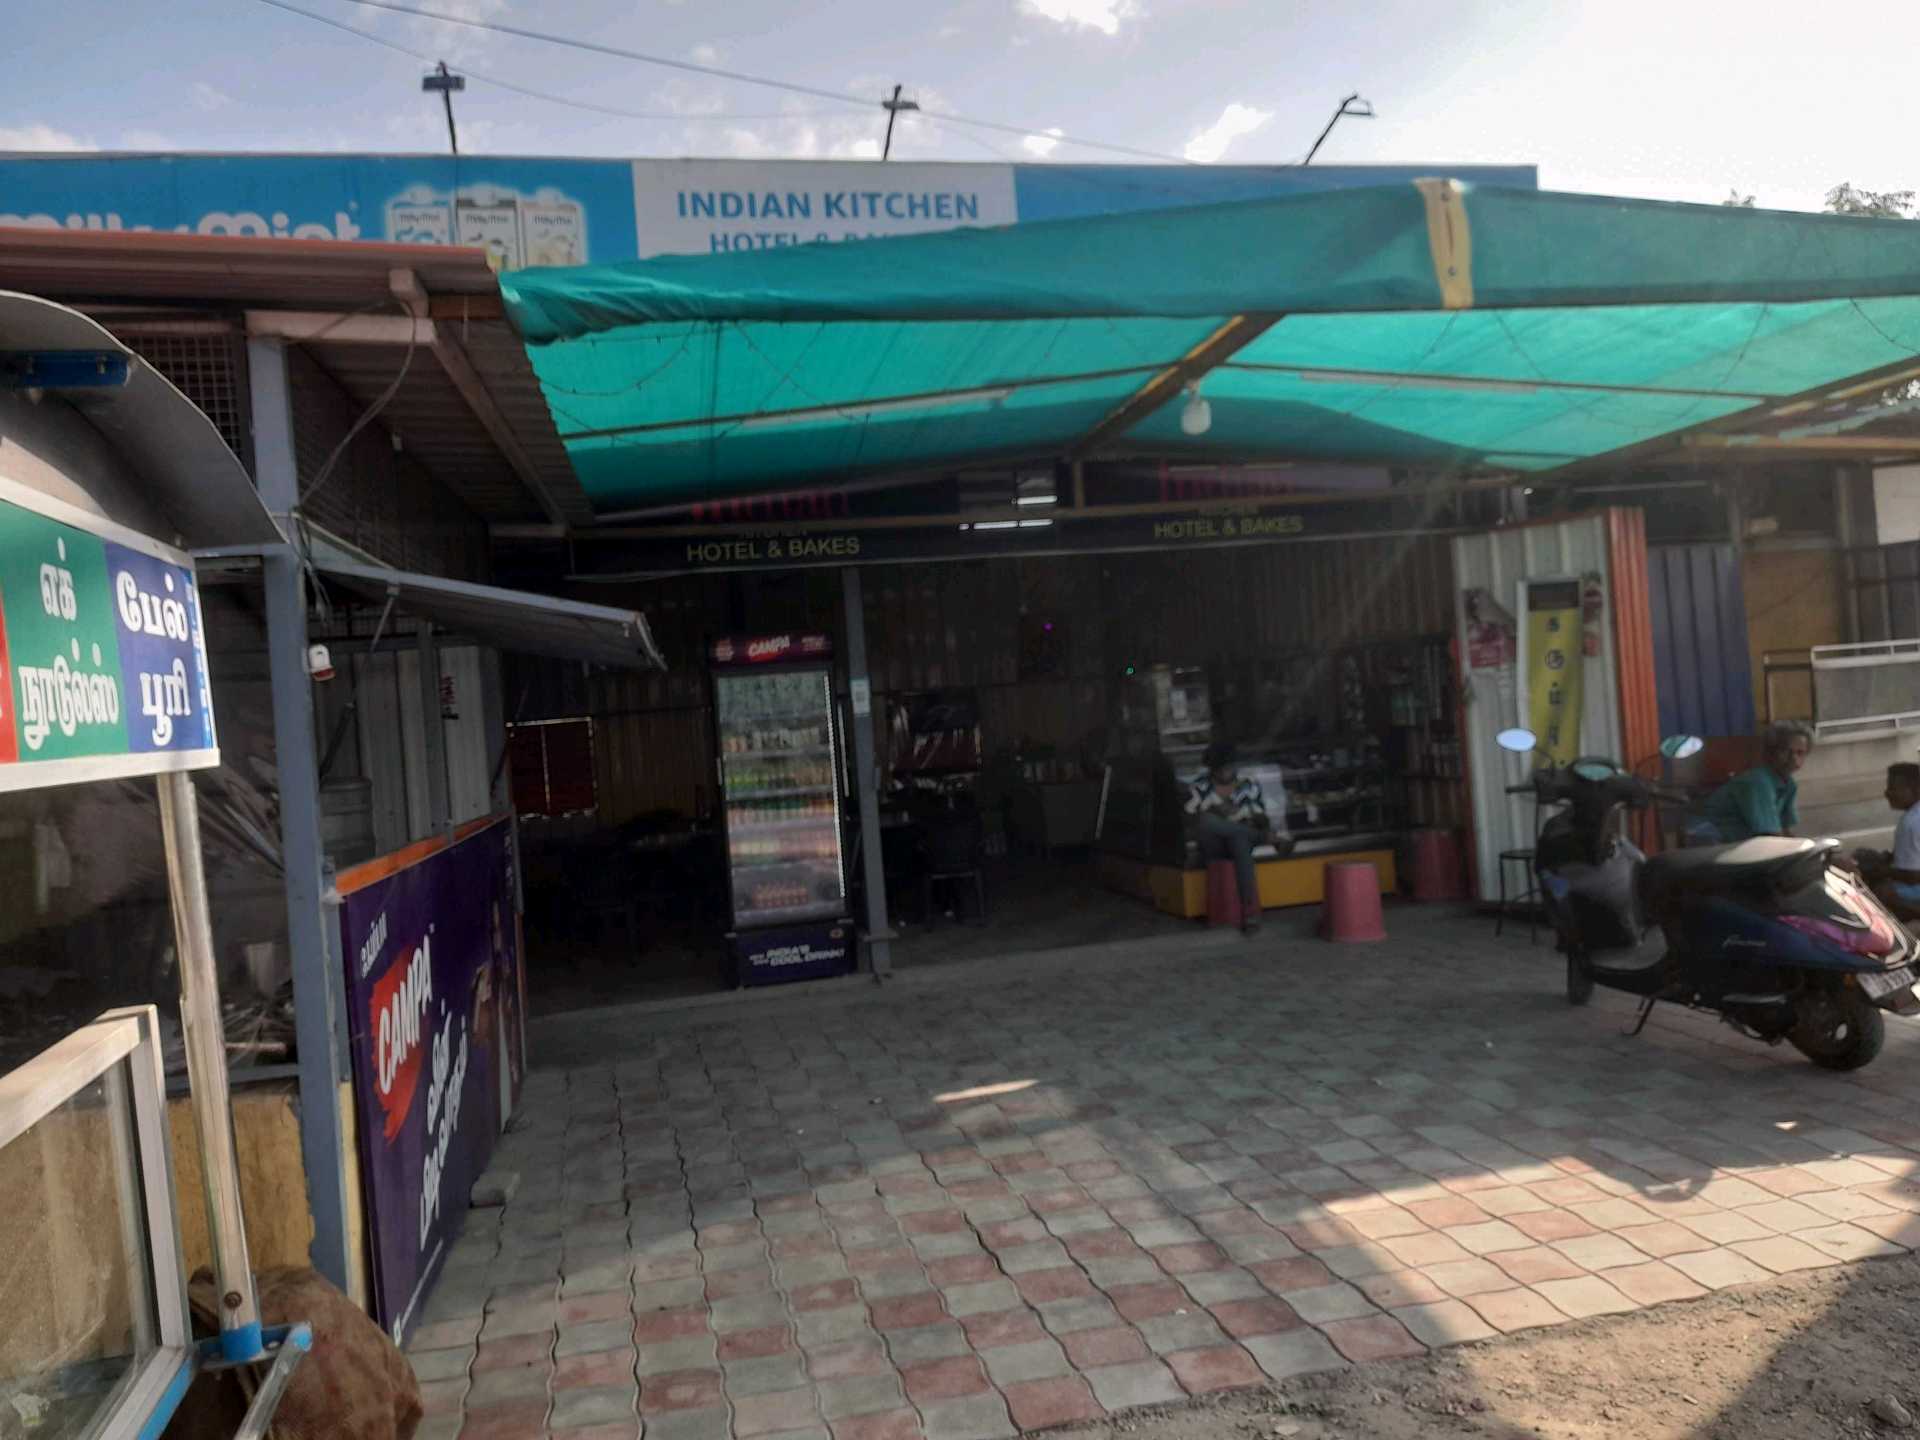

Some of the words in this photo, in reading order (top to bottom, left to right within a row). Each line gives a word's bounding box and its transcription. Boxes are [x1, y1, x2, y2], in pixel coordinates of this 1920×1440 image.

[678, 191, 811, 220] INDIAN
[824, 192, 979, 220] KITCHEN
[39, 536, 78, 622] எக்
[687, 541, 762, 562] HOTEL
[768, 539, 784, 558] &
[788, 536, 861, 558] BAKES
[115, 570, 189, 643] பேல்
[139, 657, 192, 747] பூரி
[378, 935, 433, 1096] CAMPA
